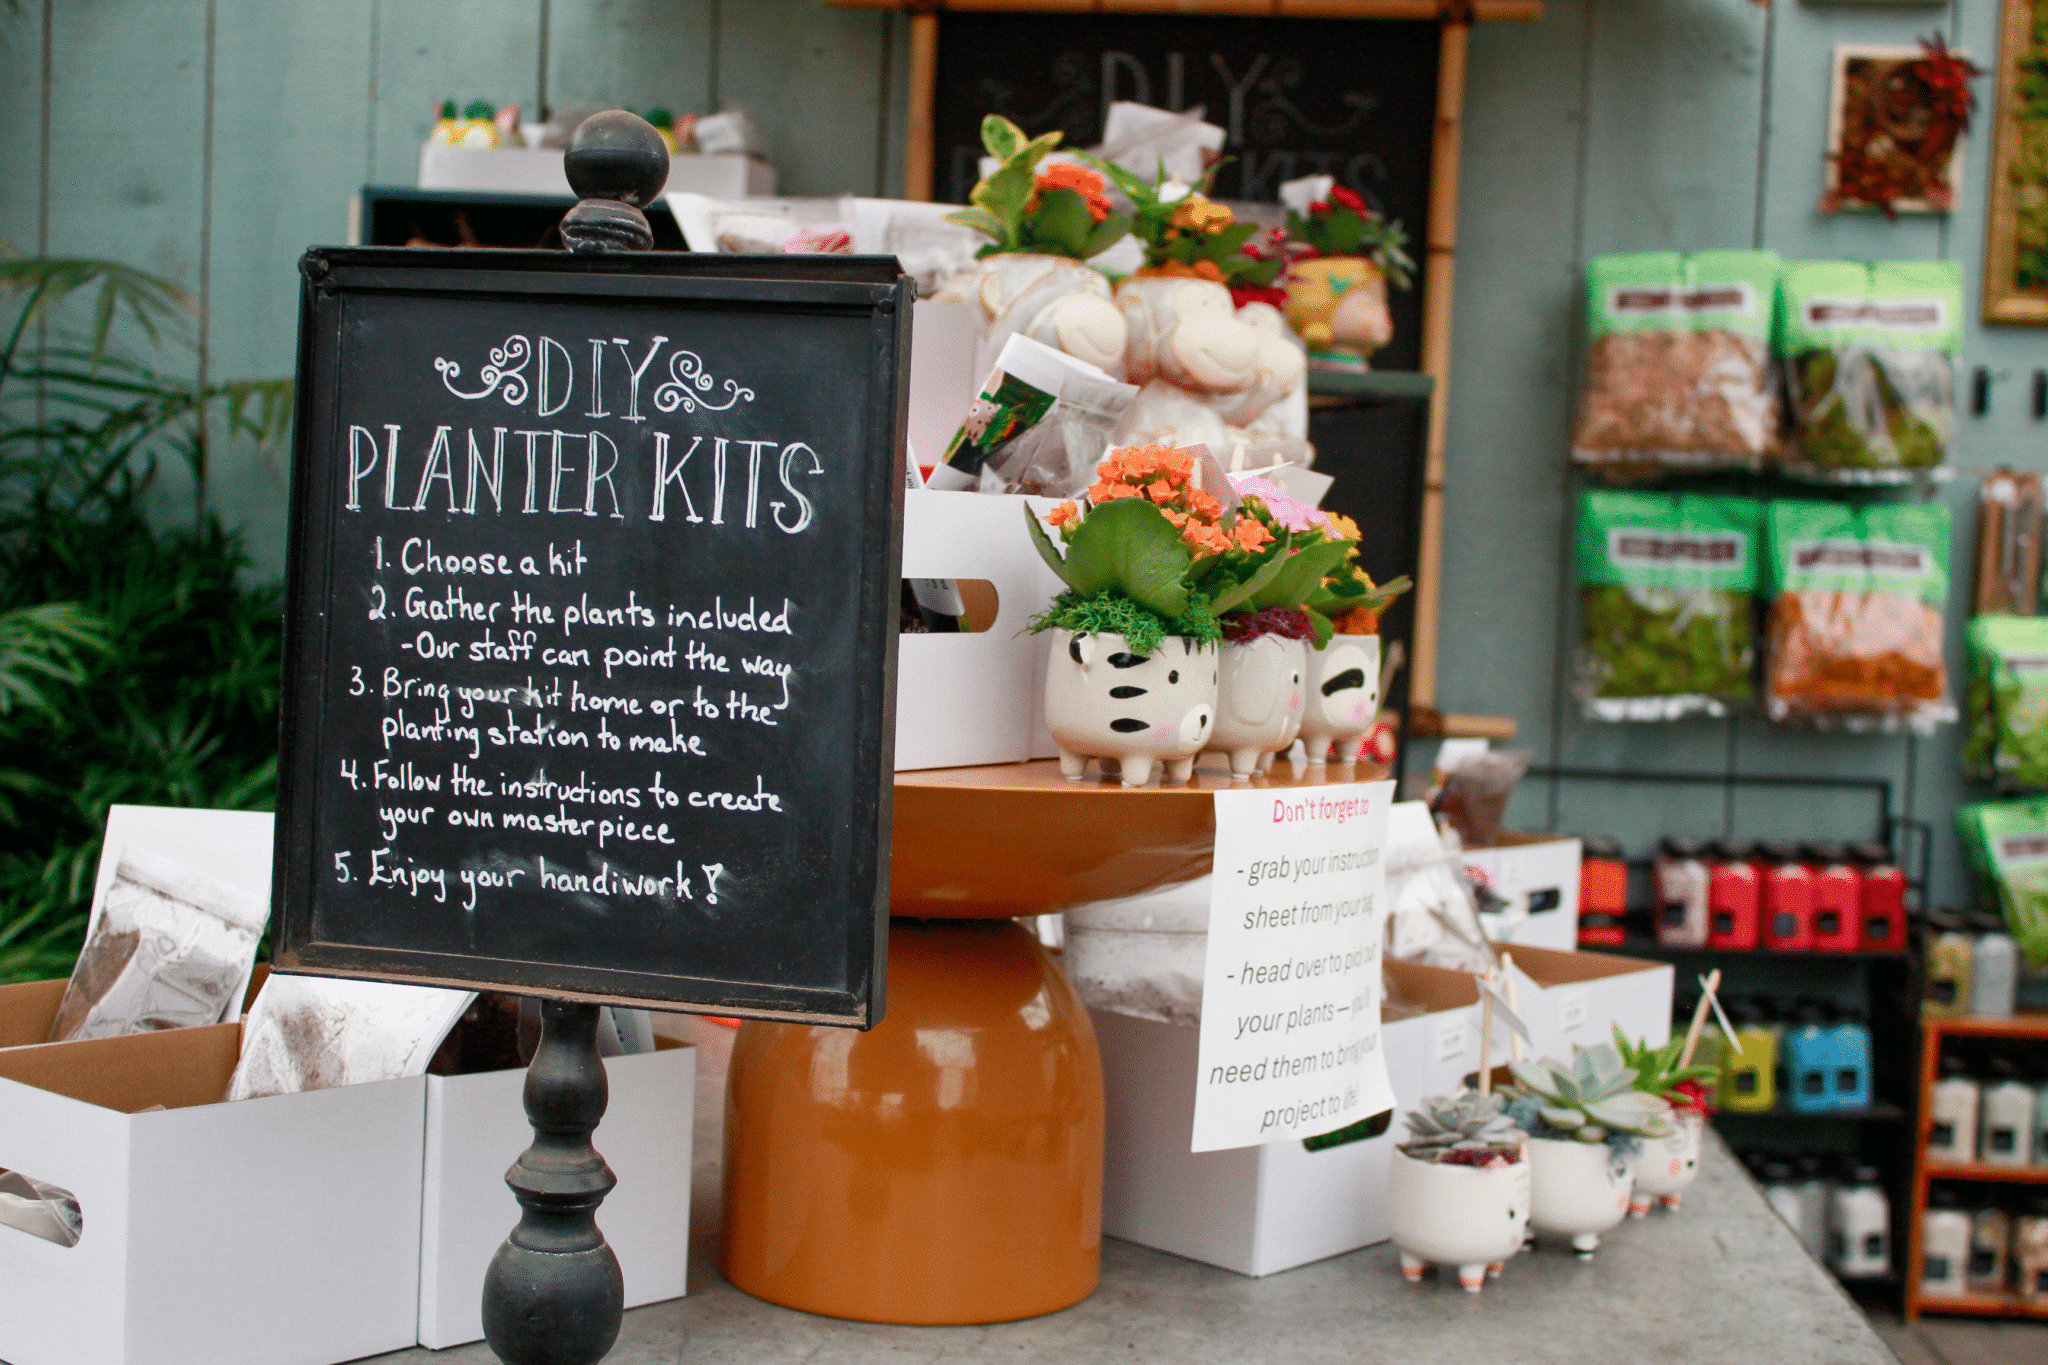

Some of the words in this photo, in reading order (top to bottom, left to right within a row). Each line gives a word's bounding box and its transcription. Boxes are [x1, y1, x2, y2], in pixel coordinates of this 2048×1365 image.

[538, 335, 669, 423] DIY
[345, 423, 624, 519] PLANTER
[649, 431, 825, 534] KITS
[376, 535, 391, 570] 1.
[401, 536, 513, 576] Choose
[519, 555, 541, 575] a
[548, 539, 588, 576] kit
[368, 584, 396, 621] 2.
[404, 584, 502, 623] Gather
[510, 590, 556, 626] the
[563, 590, 656, 637] plants
[668, 596, 794, 636] included
[468, 628, 538, 663] staff
[541, 647, 591, 668] can
[603, 636, 678, 679] point
[685, 639, 731, 674] the
[741, 656, 793, 711] way
[349, 665, 375, 697] 3.
[382, 667, 451, 723] Bring
[458, 685, 518, 719] your
[526, 675, 564, 708] kit
[570, 679, 644, 717] home
[649, 698, 680, 720] or
[691, 685, 721, 720] to
[724, 690, 778, 727] the
[381, 708, 481, 760] planting
[489, 708, 590, 748] station
[596, 716, 622, 752] to
[628, 718, 707, 757] make
[339, 758, 367, 790] 4.
[372, 759, 442, 793] Follow
[449, 762, 494, 797] the
[499, 767, 641, 807] instructions
[647, 771, 680, 810] to
[688, 775, 784, 813] create
[379, 804, 435, 841] your
[447, 808, 495, 829] own
[1273, 797, 1316, 824] Don't
[1318, 796, 1359, 825] forget
[334, 851, 358, 884] 5.
[368, 847, 447, 904] Enjoy
[459, 866, 526, 911] your
[1247, 855, 1291, 887] grab
[1293, 856, 1327, 884] your
[1243, 904, 1298, 930] sheet
[1299, 900, 1334, 925] from
[1240, 957, 1291, 986] head
[1295, 958, 1328, 980] over
[1329, 953, 1342, 974] to
[1234, 1013, 1284, 1041] your
[1285, 1002, 1335, 1035] plants
[1209, 1057, 1269, 1085] need
[1271, 1053, 1318, 1080] them
[1320, 1050, 1334, 1070] to
[1259, 1096, 1326, 1134] project
[1327, 1093, 1341, 1115] to
